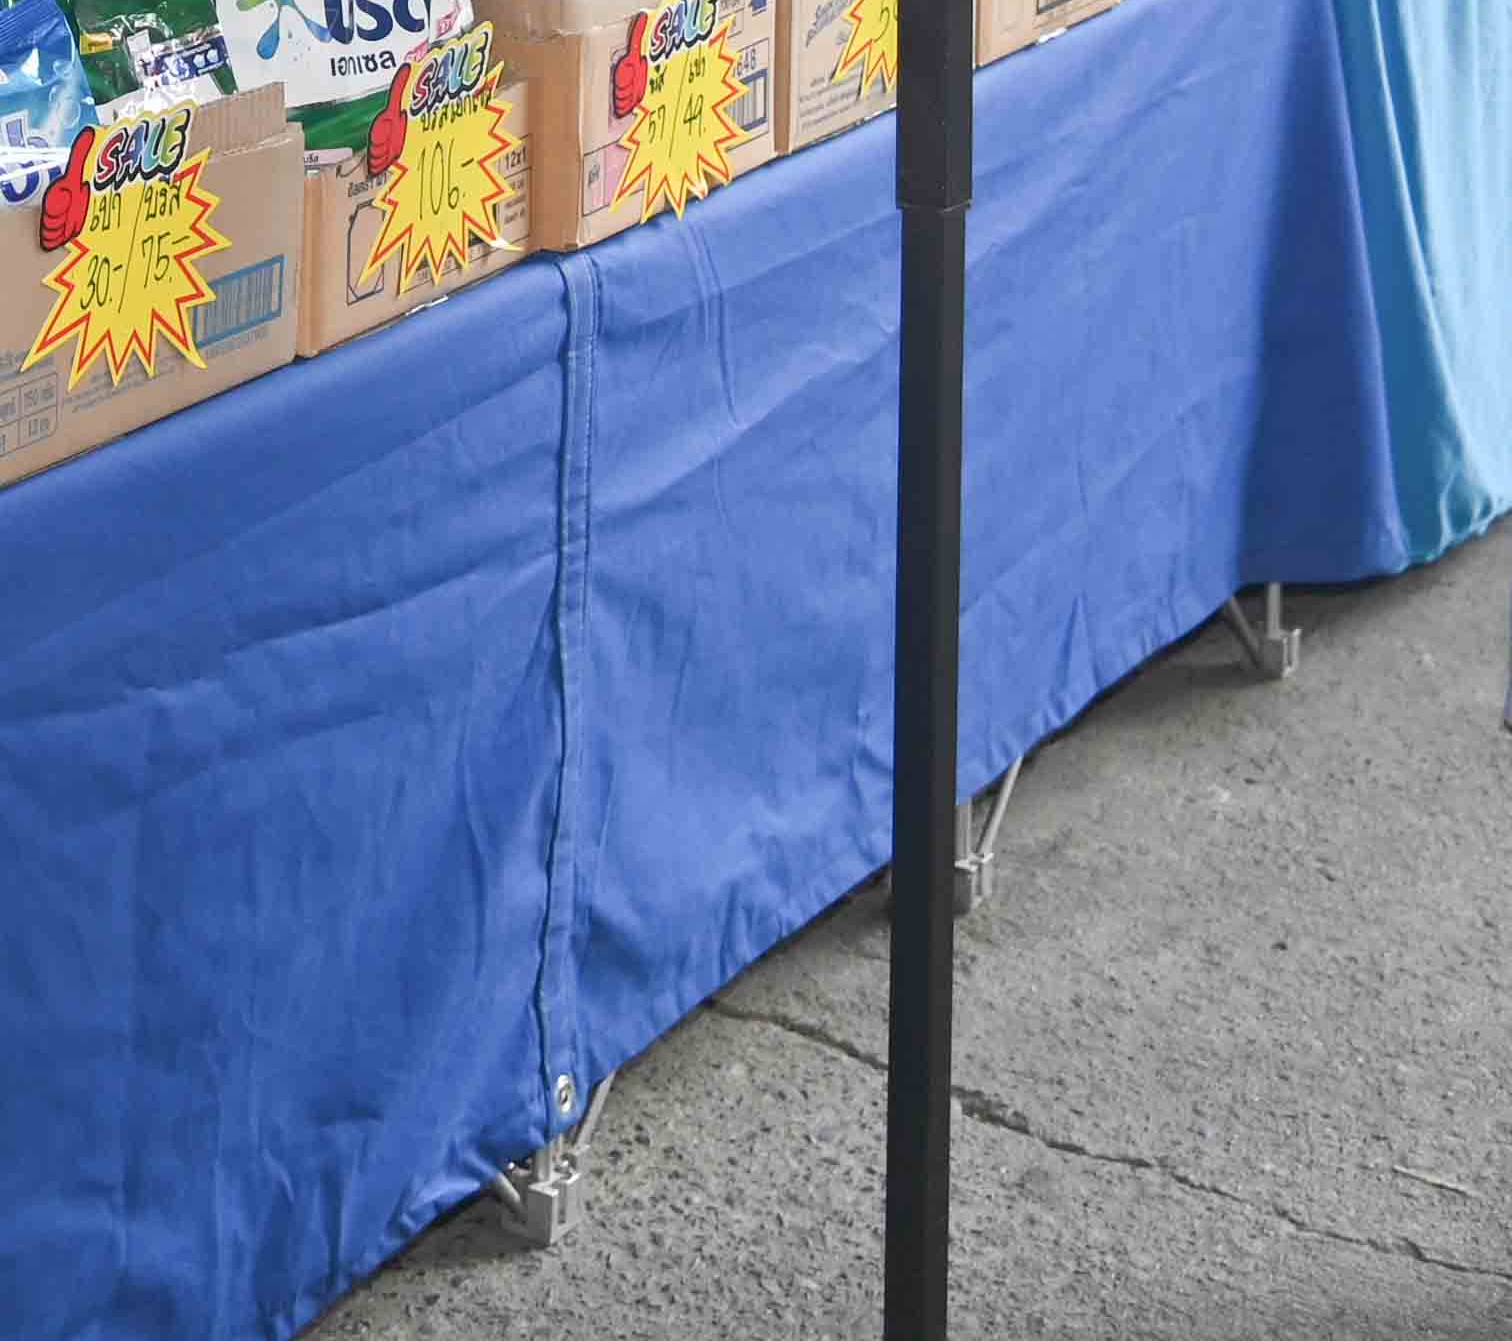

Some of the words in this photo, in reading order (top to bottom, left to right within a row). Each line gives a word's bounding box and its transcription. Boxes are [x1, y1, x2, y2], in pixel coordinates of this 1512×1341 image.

[329, 50, 397, 78] เอกเซล
[409, 31, 491, 117] SALE
[93, 107, 191, 191] SALE
[417, 137, 475, 221] 106.-
